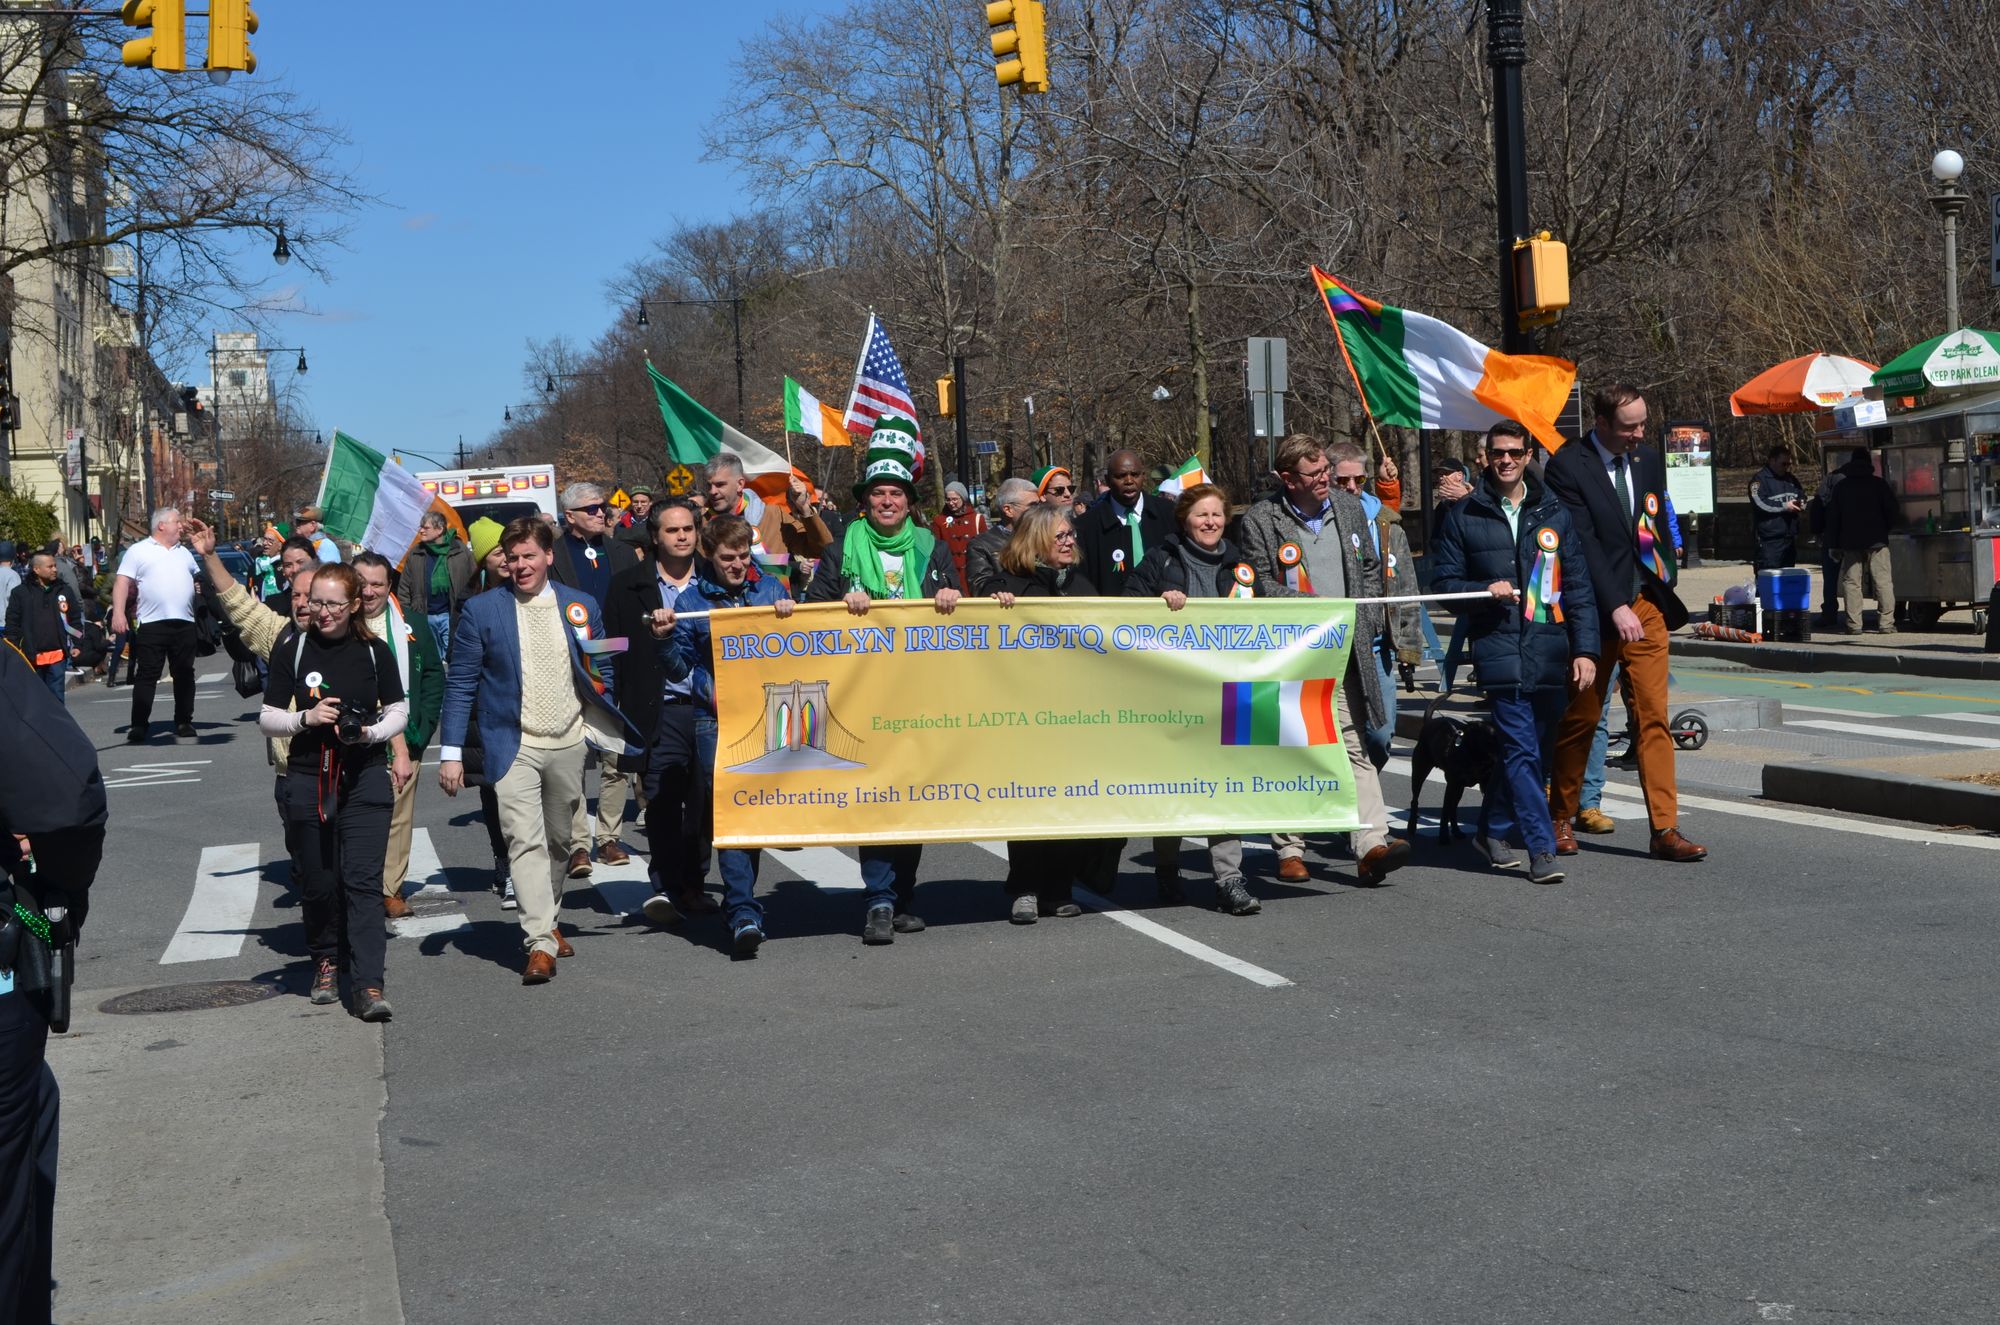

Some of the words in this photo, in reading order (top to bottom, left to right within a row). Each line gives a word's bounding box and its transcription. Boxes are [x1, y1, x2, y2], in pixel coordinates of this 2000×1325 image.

[1929, 370, 1949, 382] KEEP
[1951, 368, 1972, 380] PARK
[1974, 365, 1998, 378] CLEAN
[720, 626, 896, 660] BROOKLYN
[904, 624, 989, 652] IRISH
[999, 624, 1107, 653] LGBTQ
[1112, 624, 1348, 650] ORGANIZATION
[872, 713, 961, 733] Eagraíocht
[967, 712, 1029, 727] LADTA
[1035, 709, 1111, 725] Ghaelach
[1117, 709, 1204, 728] Bhrooklyn
[733, 787, 848, 809] Celebrating
[855, 783, 900, 804] Irish
[908, 782, 982, 803] LGBTQ
[987, 781, 1057, 799] culture
[1064, 779, 1099, 797] and
[1106, 777, 1218, 798] community
[1225, 776, 1244, 793] in
[1252, 775, 1339, 796] Brooklyn
